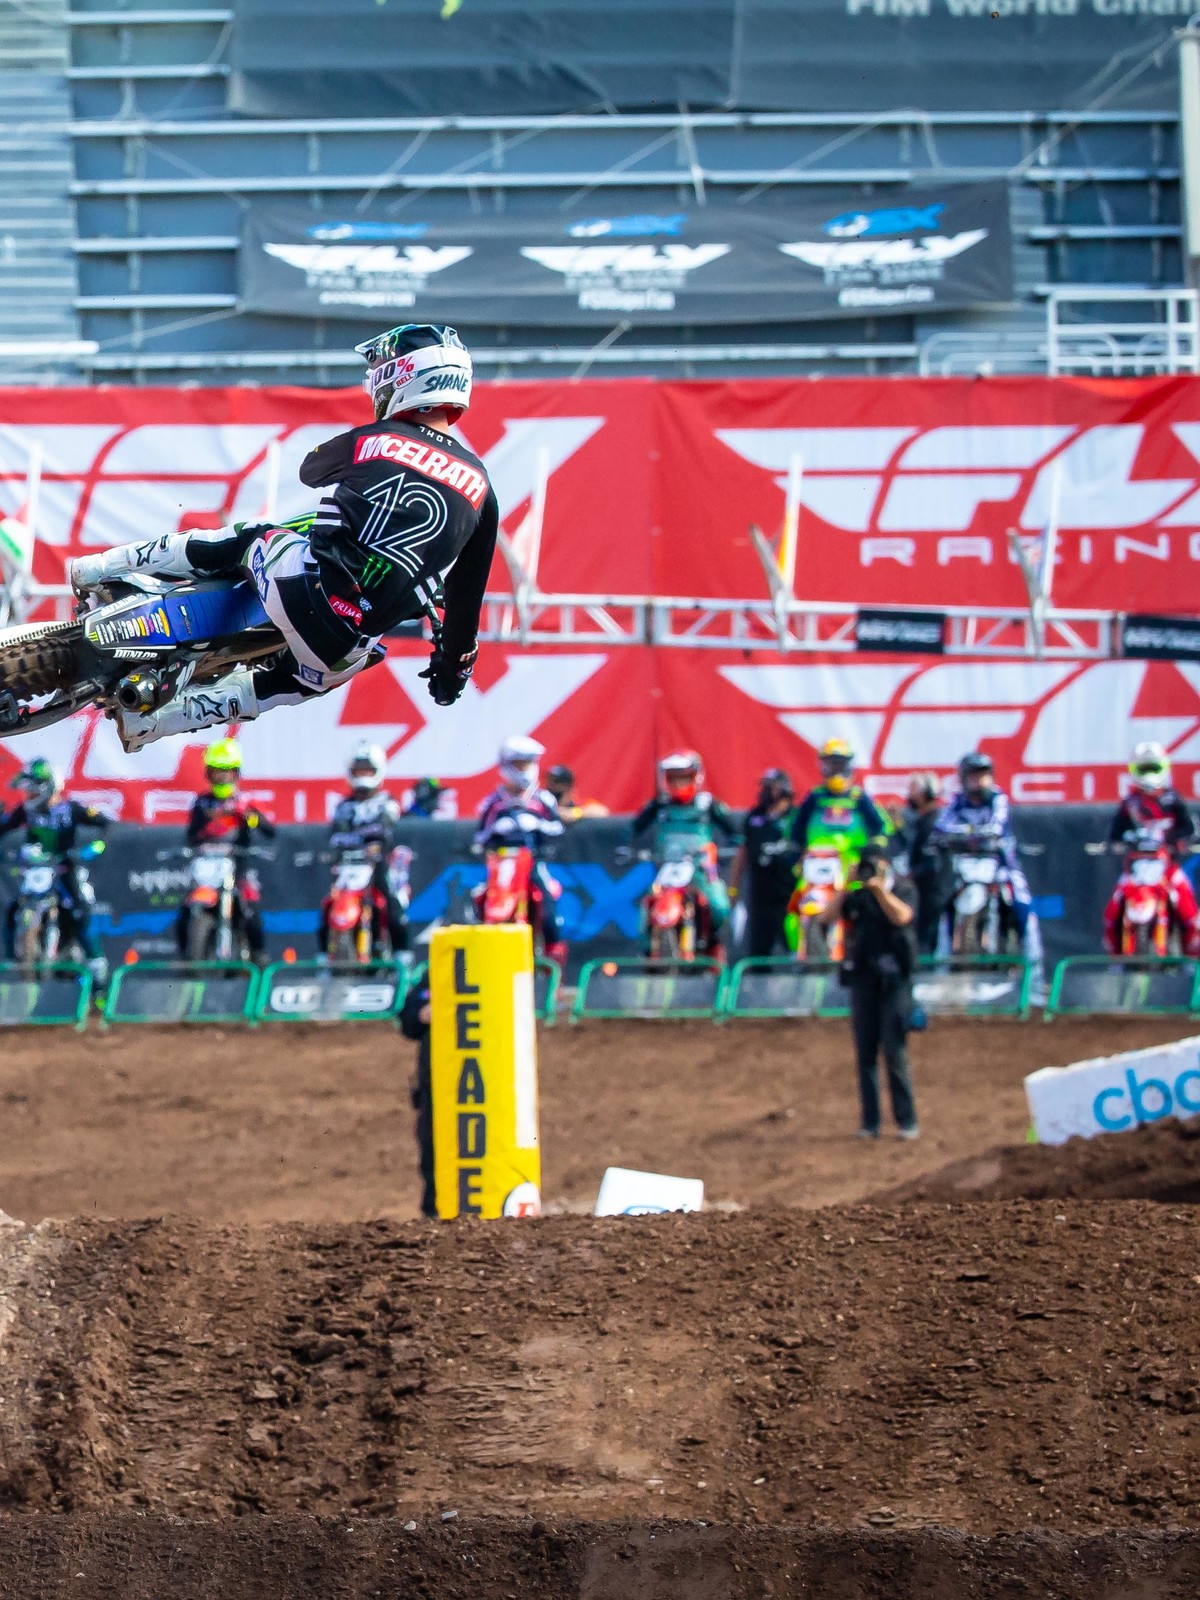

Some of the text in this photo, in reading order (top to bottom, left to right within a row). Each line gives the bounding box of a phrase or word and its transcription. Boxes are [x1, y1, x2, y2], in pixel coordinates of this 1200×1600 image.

[395, 374, 414, 388] BELL
[420, 371, 470, 394] SHANE
[419, 425, 453, 447] THOR
[357, 433, 487, 503] MCELRATH
[356, 472, 448, 578] 12
[113, 648, 159, 661] DUNLOP
